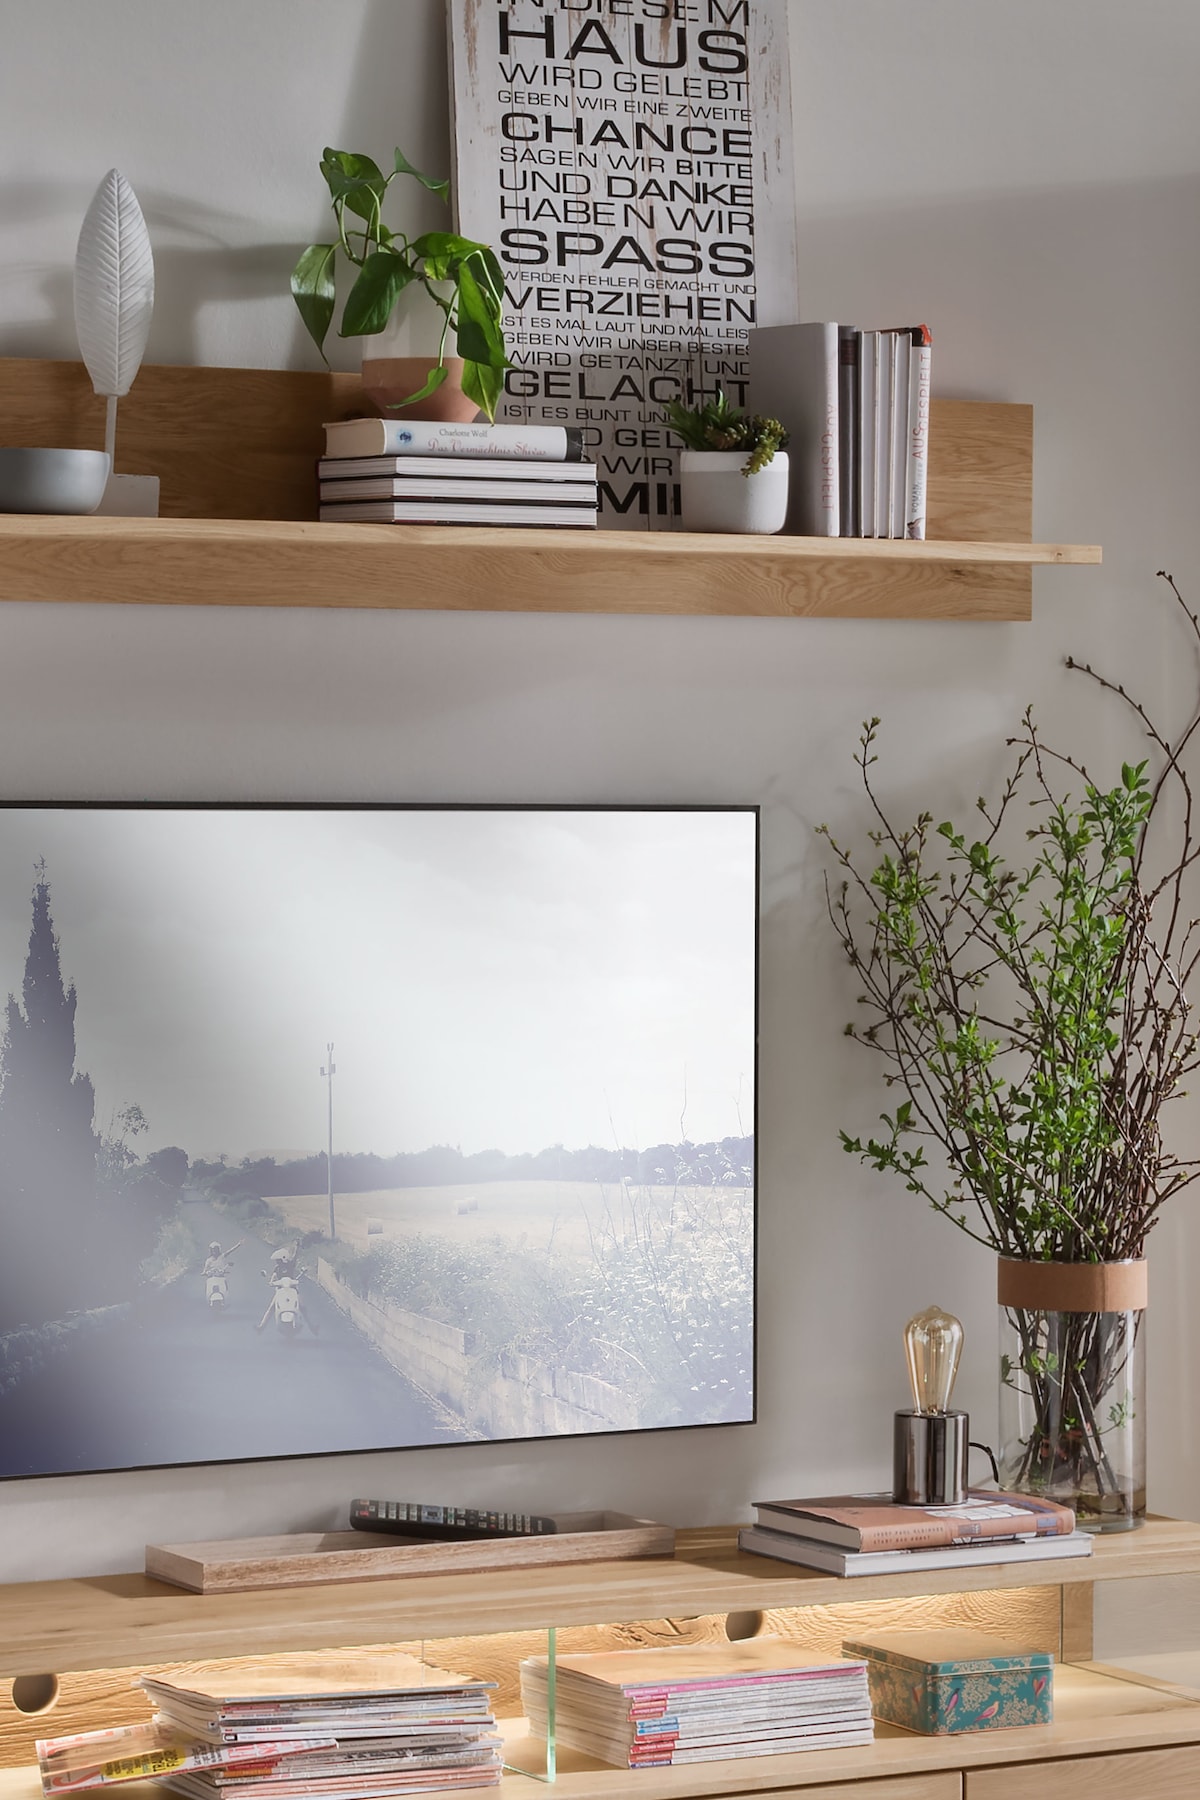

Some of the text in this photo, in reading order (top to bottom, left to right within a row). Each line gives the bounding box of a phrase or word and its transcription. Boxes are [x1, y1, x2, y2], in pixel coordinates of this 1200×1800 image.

[498, 11, 750, 74] HAUS
[499, 62, 750, 101] WIRD GELEBT
[497, 90, 752, 122] GEBEN WIR EINE ZWEITE
[501, 112, 753, 158] CHANCE
[500, 147, 753, 180] SAGEN WIR BITTE
[499, 168, 754, 207] UND DANKE
[499, 195, 755, 236] HABEN WIR
[500, 228, 755, 278] SPASS
[503, 270, 757, 295] WERDEN FEHLER GEMACHT UND
[503, 285, 756, 323] VERZIEHEN
[500, 315, 526, 327] IST
[531, 317, 551, 329] ES
[556, 319, 591, 331] MAL
[595, 320, 636, 333] LAUT
[641, 324, 675, 336] UND
[679, 325, 714, 337] MAL
[503, 332, 749, 356] GEBEN WIR UNSER BESTE
[509, 350, 572, 366] WIRD
[579, 353, 695, 373] GETANZT
[503, 369, 750, 407] GELACHT
[503, 404, 671, 423] IST ES BUNT UN
[602, 455, 673, 476] WIR
